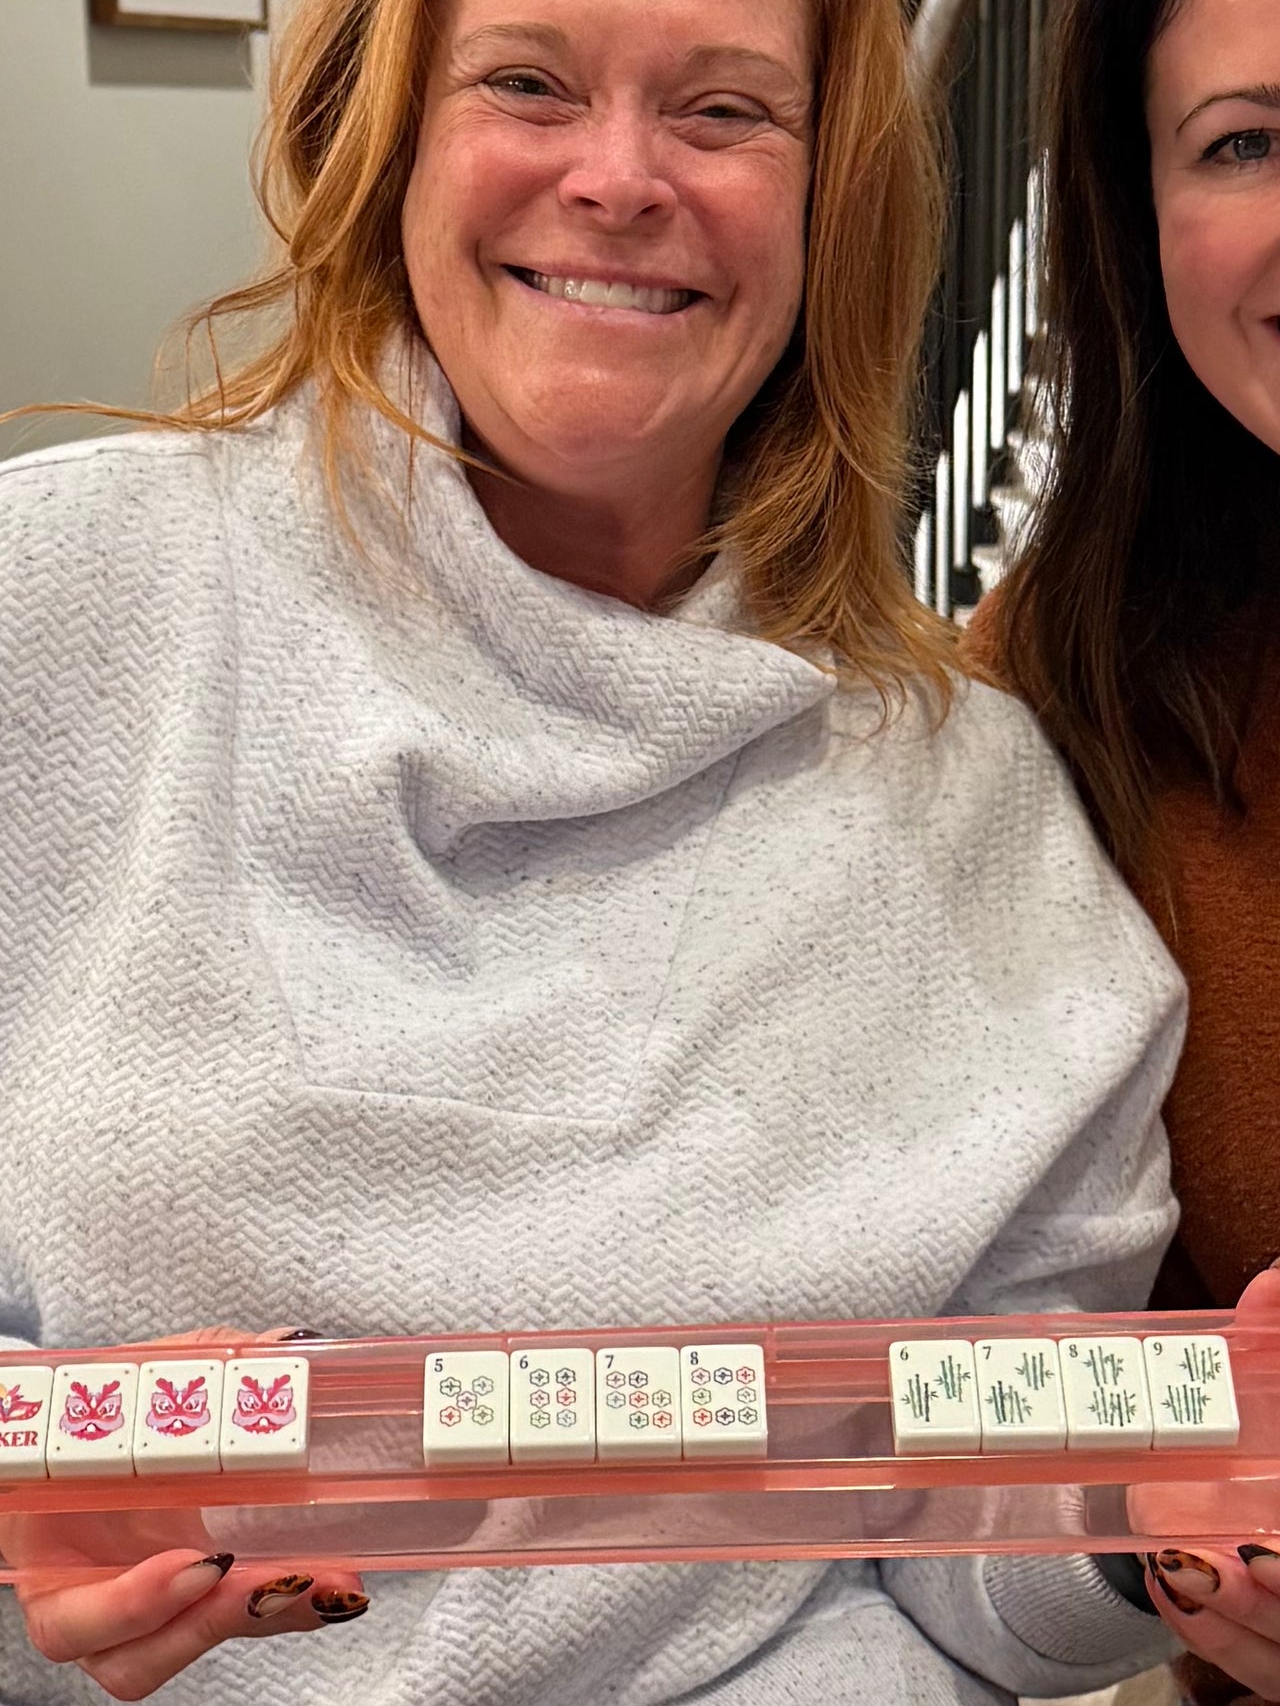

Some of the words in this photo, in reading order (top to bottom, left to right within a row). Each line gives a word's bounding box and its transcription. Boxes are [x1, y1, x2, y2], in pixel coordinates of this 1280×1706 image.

[899, 1346, 909, 1361] 6
[982, 1345, 992, 1360] 7
[1069, 1344, 1079, 1358] 8
[1153, 1342, 1163, 1356] 9
[434, 1358, 444, 1373] 5
[519, 1354, 529, 1370] 6
[605, 1354, 615, 1369] 7
[689, 1351, 699, 1366] 8
